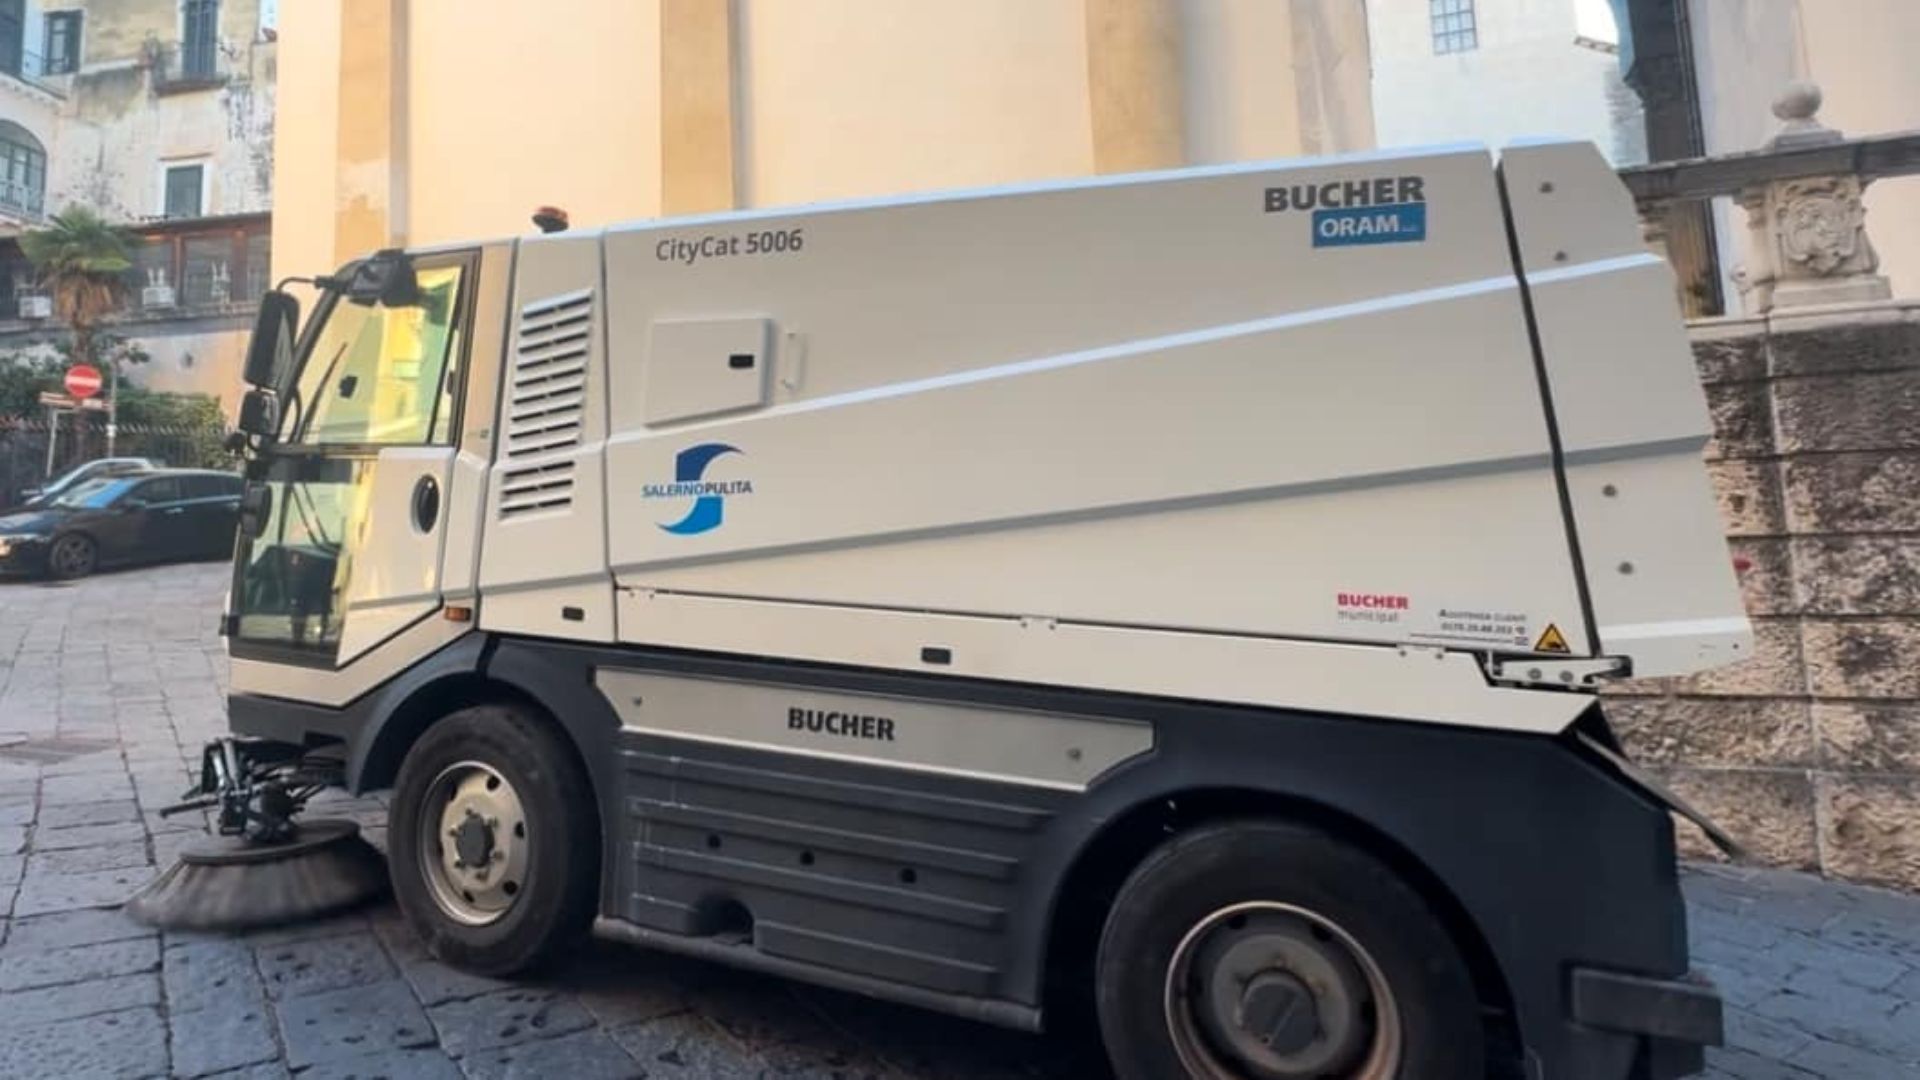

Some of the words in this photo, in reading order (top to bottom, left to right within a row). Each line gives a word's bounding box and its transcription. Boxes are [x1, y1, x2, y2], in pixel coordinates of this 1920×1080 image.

[1264, 176, 1426, 213] BUCHER
[1319, 214, 1399, 238] ORAM
[655, 236, 740, 265] CityCat
[745, 229, 803, 254] 5006
[641, 481, 753, 498] SALERNOPULITA
[1337, 593, 1409, 609] BUCHER
[787, 706, 895, 741] BUCHER
